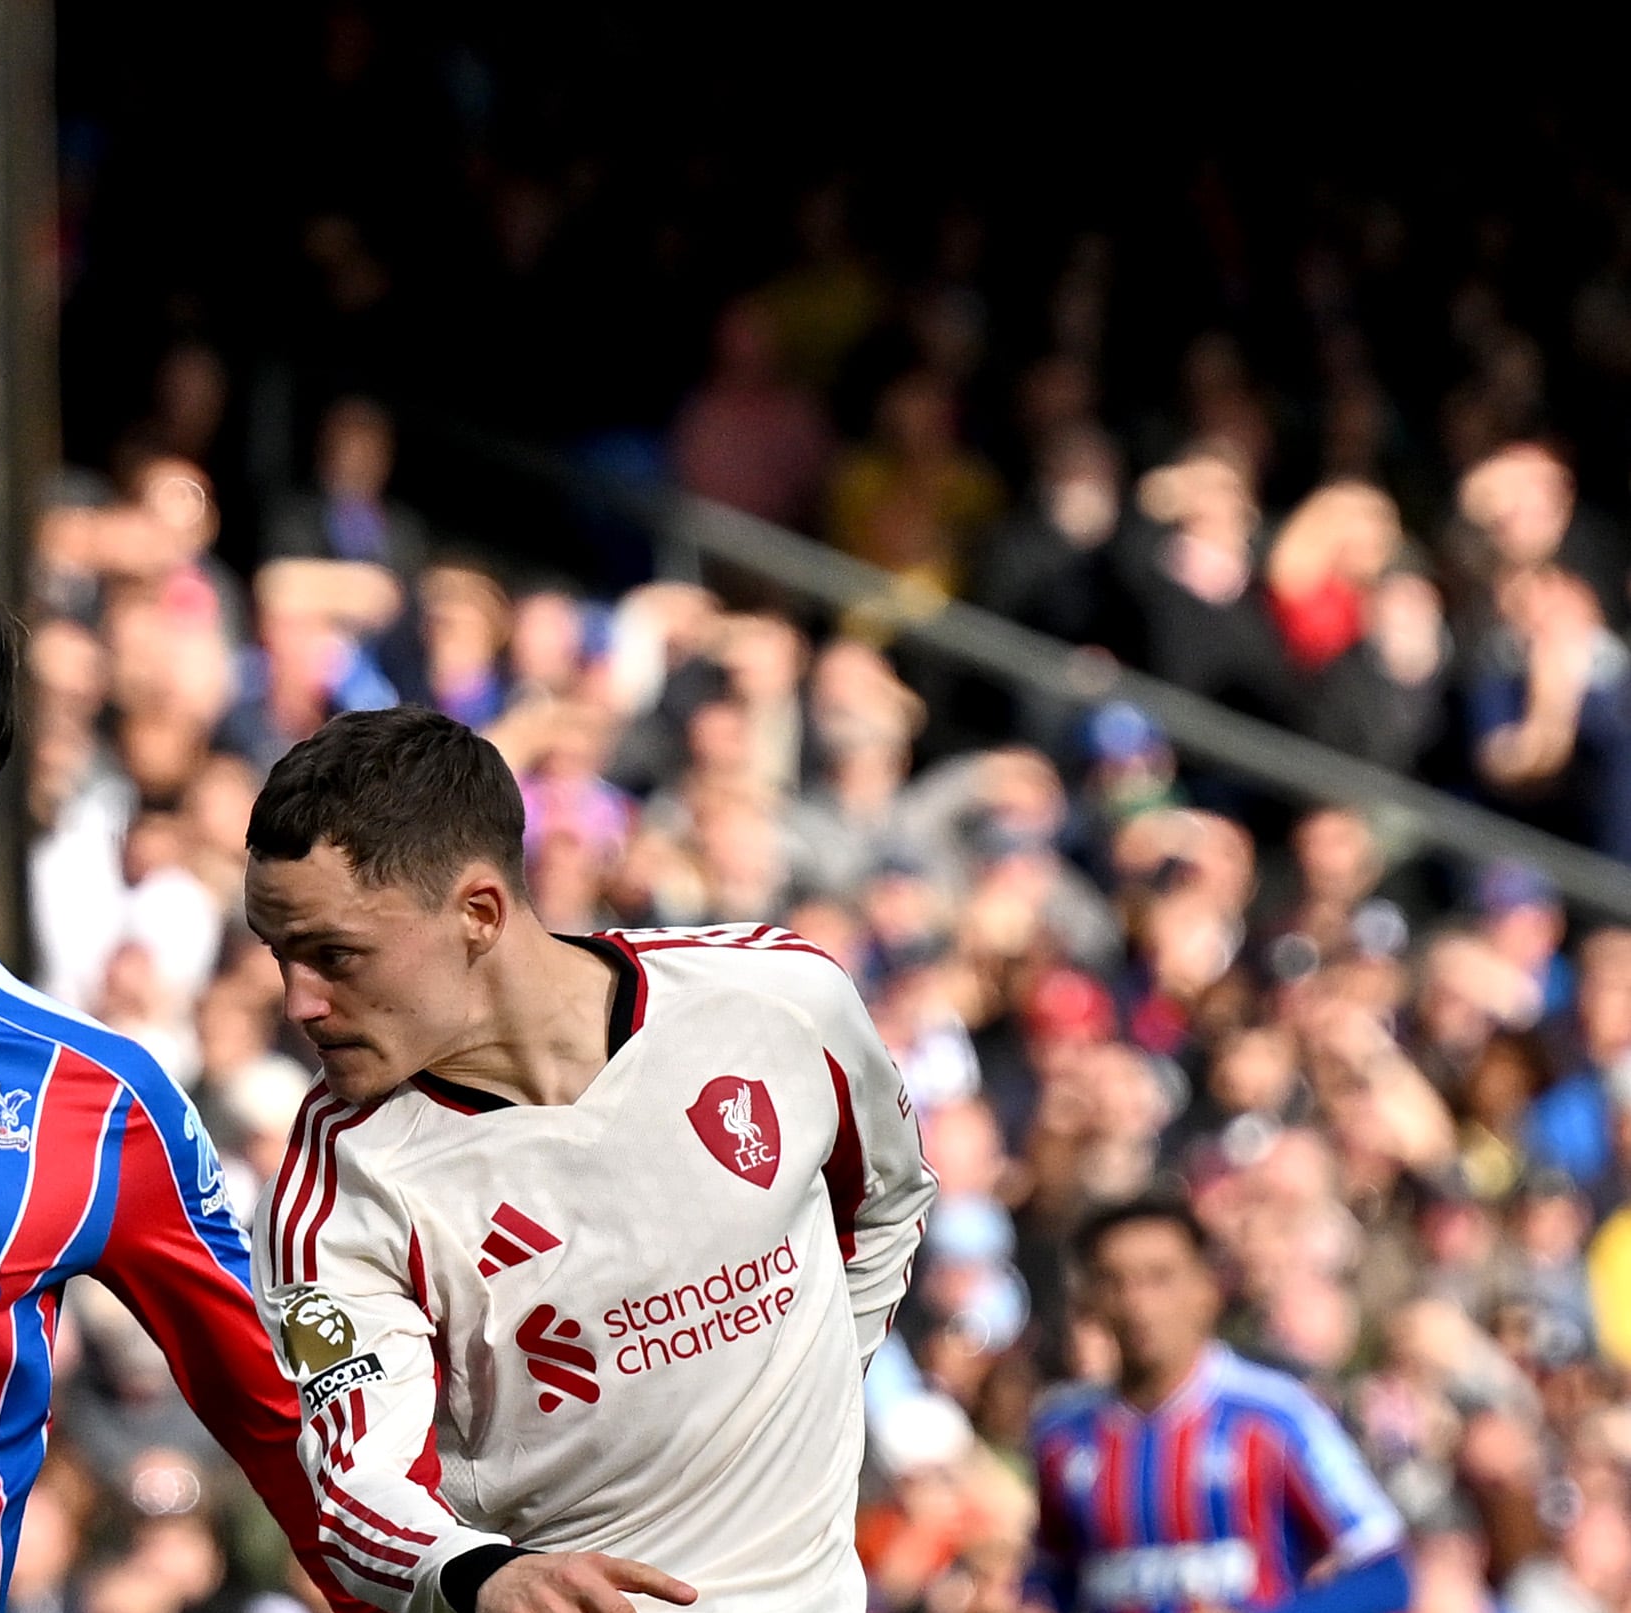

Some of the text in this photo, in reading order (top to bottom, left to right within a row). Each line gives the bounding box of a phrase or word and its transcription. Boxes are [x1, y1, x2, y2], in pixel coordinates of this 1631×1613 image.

[603, 1234, 798, 1338] standard
[616, 1287, 794, 1375] chartere
[314, 1360, 371, 1398] room
